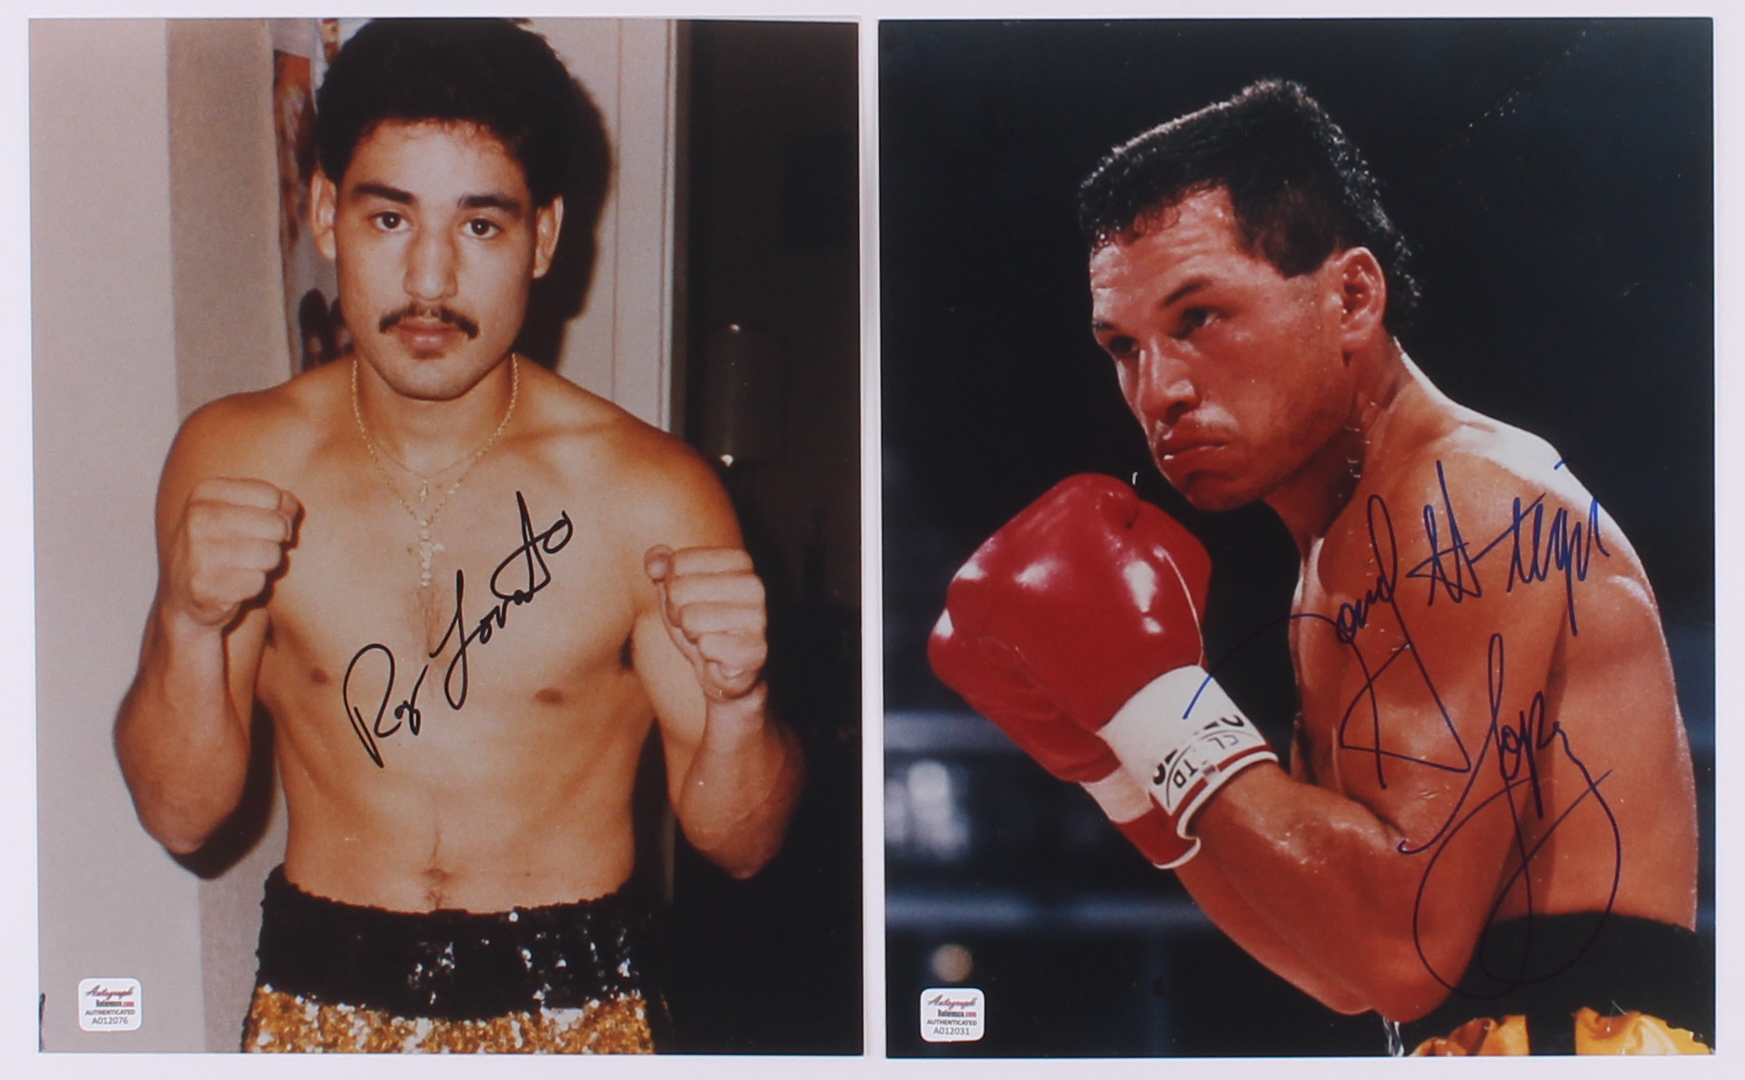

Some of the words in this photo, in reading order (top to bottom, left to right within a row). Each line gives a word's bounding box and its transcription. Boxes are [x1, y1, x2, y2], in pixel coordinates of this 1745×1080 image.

[85, 984, 136, 1000] Autograph
[926, 994, 978, 1010] Autograph
[92, 1016, 129, 1025] A012076
[933, 1027, 971, 1036] A012031
